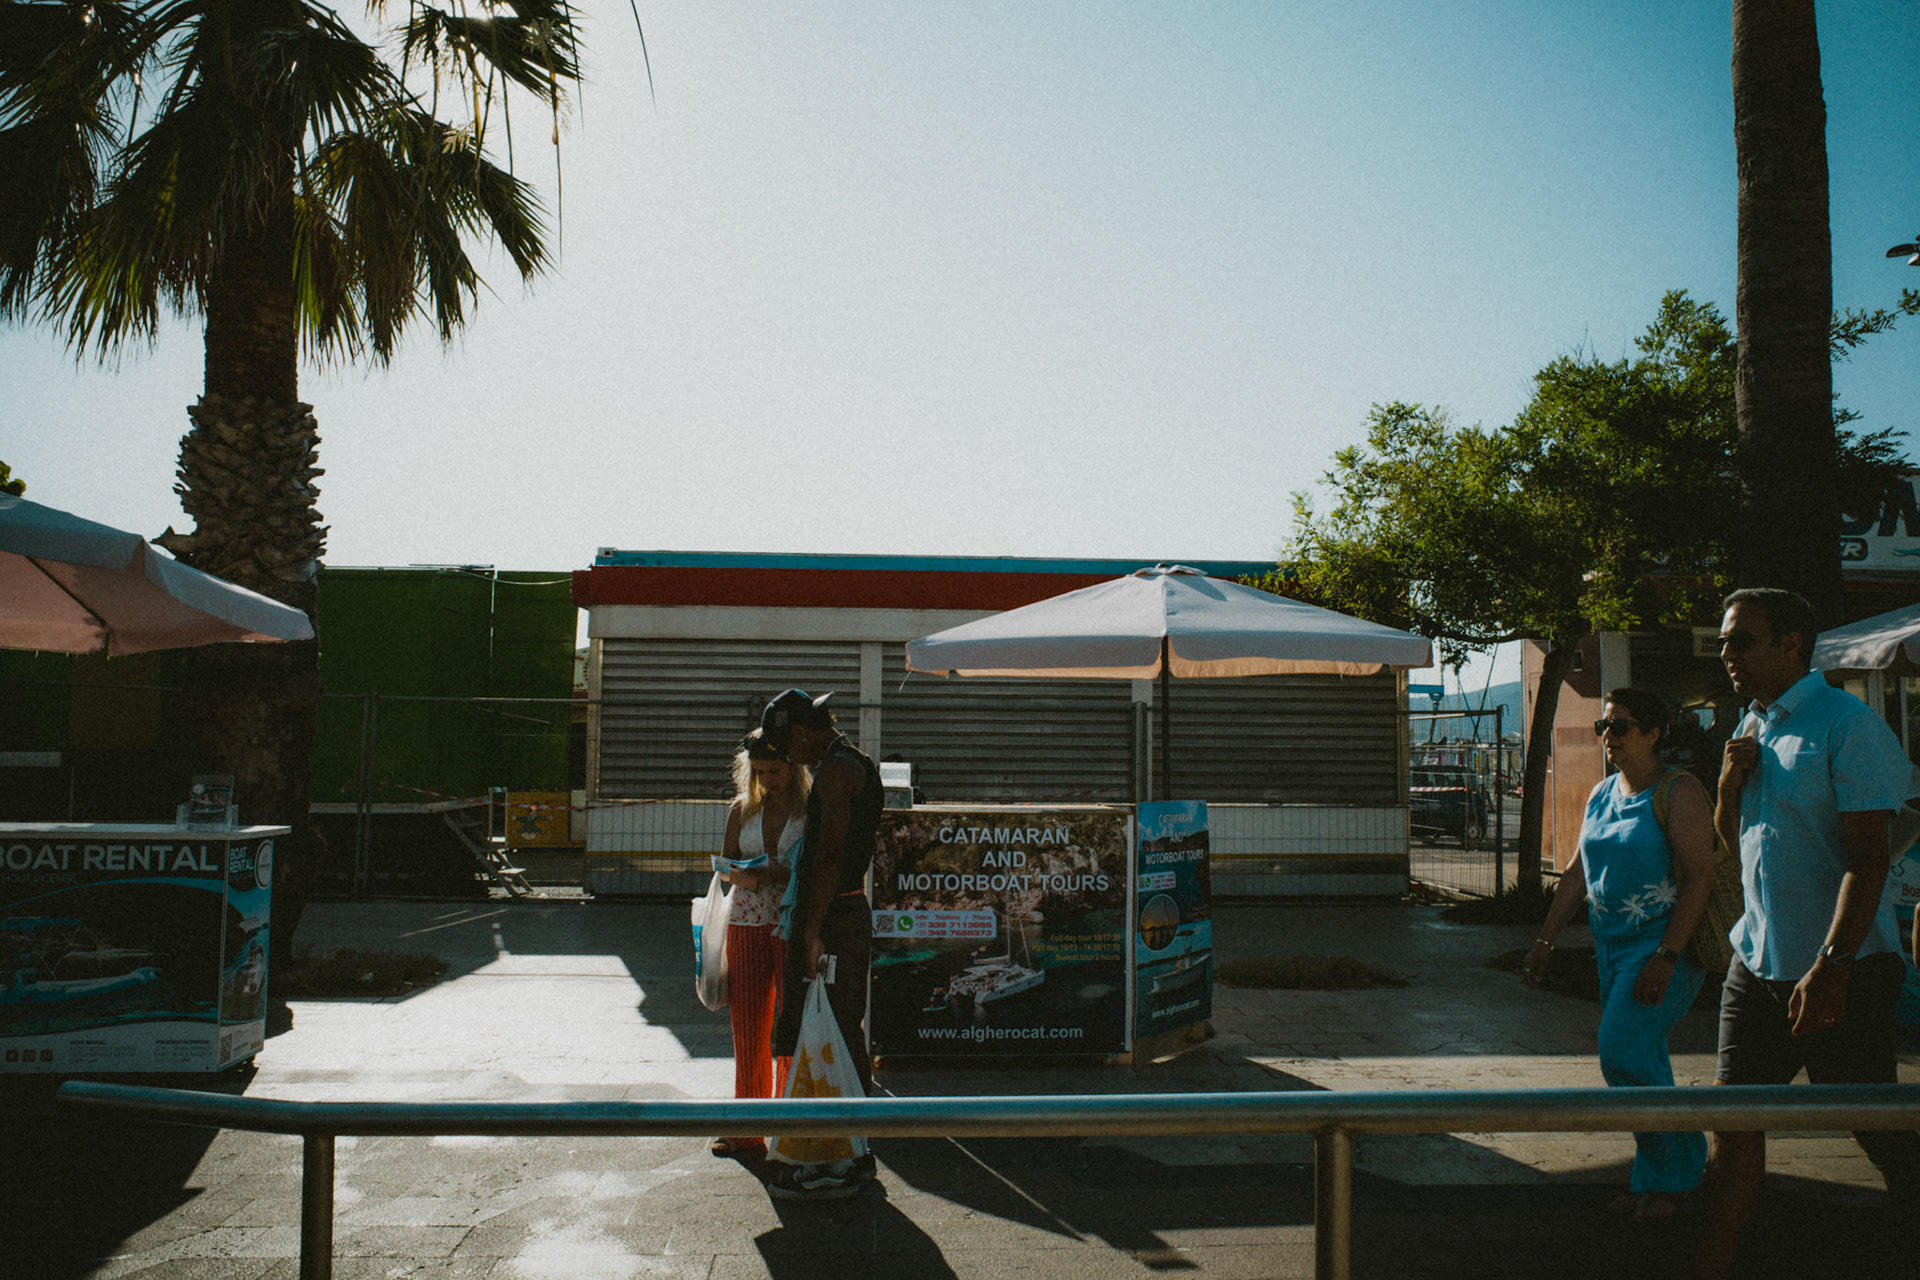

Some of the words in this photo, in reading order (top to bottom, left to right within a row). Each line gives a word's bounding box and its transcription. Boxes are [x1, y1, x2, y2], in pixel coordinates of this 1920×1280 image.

[1158, 813, 1193, 824] CATAMARAN
[939, 827, 1069, 844] CATAMARAN
[1170, 832, 1184, 843] AND
[0, 845, 77, 871] OAT
[84, 845, 219, 871] RENTAL
[230, 846, 248, 860] BOAT
[982, 851, 1027, 867] AND
[1145, 850, 1185, 865] MOTORBOAT
[1186, 849, 1204, 861] TOURS
[229, 857, 254, 873] RENTAL
[898, 874, 1031, 891] MOTORBOAT
[1039, 874, 1109, 891] TOURS
[917, 1026, 1083, 1042] www.algherocat.com
